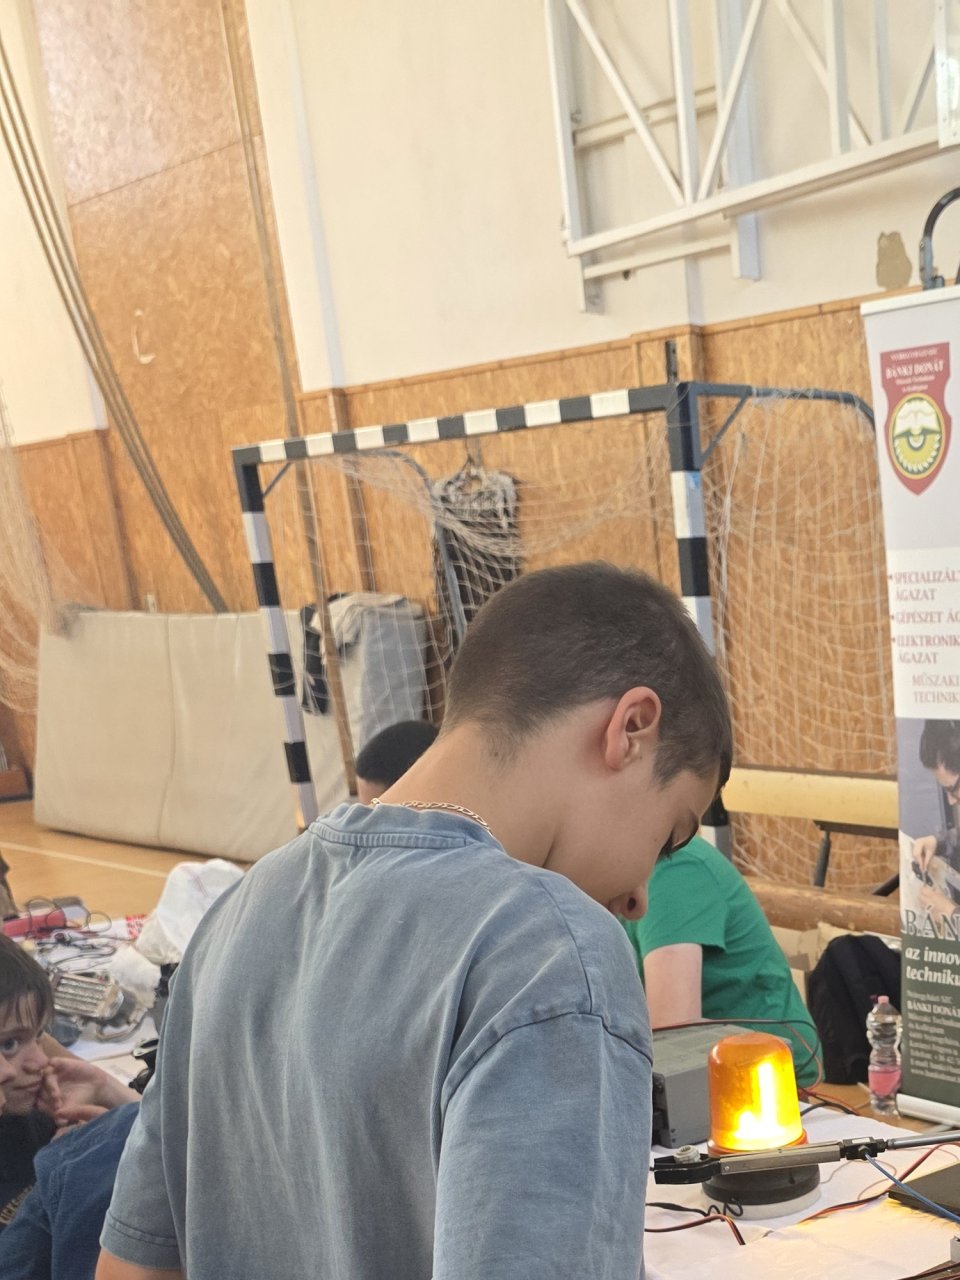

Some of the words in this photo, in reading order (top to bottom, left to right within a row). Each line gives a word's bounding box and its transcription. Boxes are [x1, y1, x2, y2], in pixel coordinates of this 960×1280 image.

[896, 587, 937, 602] ÁGAZAT
[896, 610, 944, 625] GÉPÉSZET
[912, 671, 960, 688] MŰSZAKI
[904, 947, 920, 961] az
